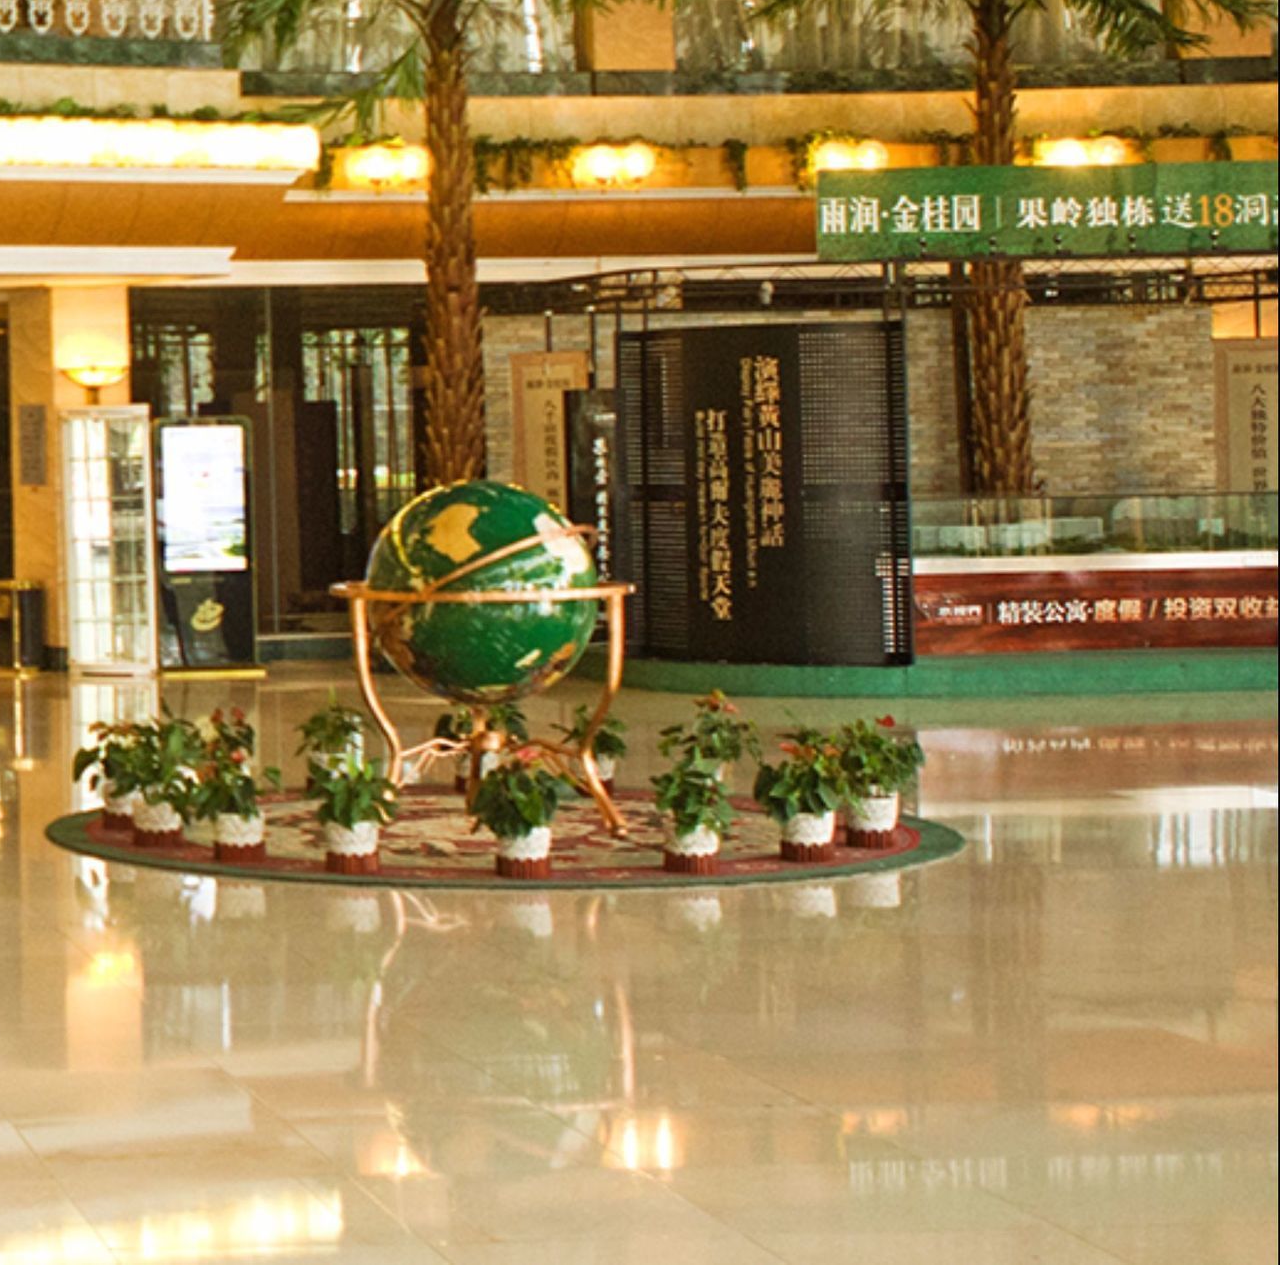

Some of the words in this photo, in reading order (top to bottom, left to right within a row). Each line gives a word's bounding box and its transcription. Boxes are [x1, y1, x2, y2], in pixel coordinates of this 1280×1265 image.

[1016, 193, 1278, 228] 果岭独栋送18洞
